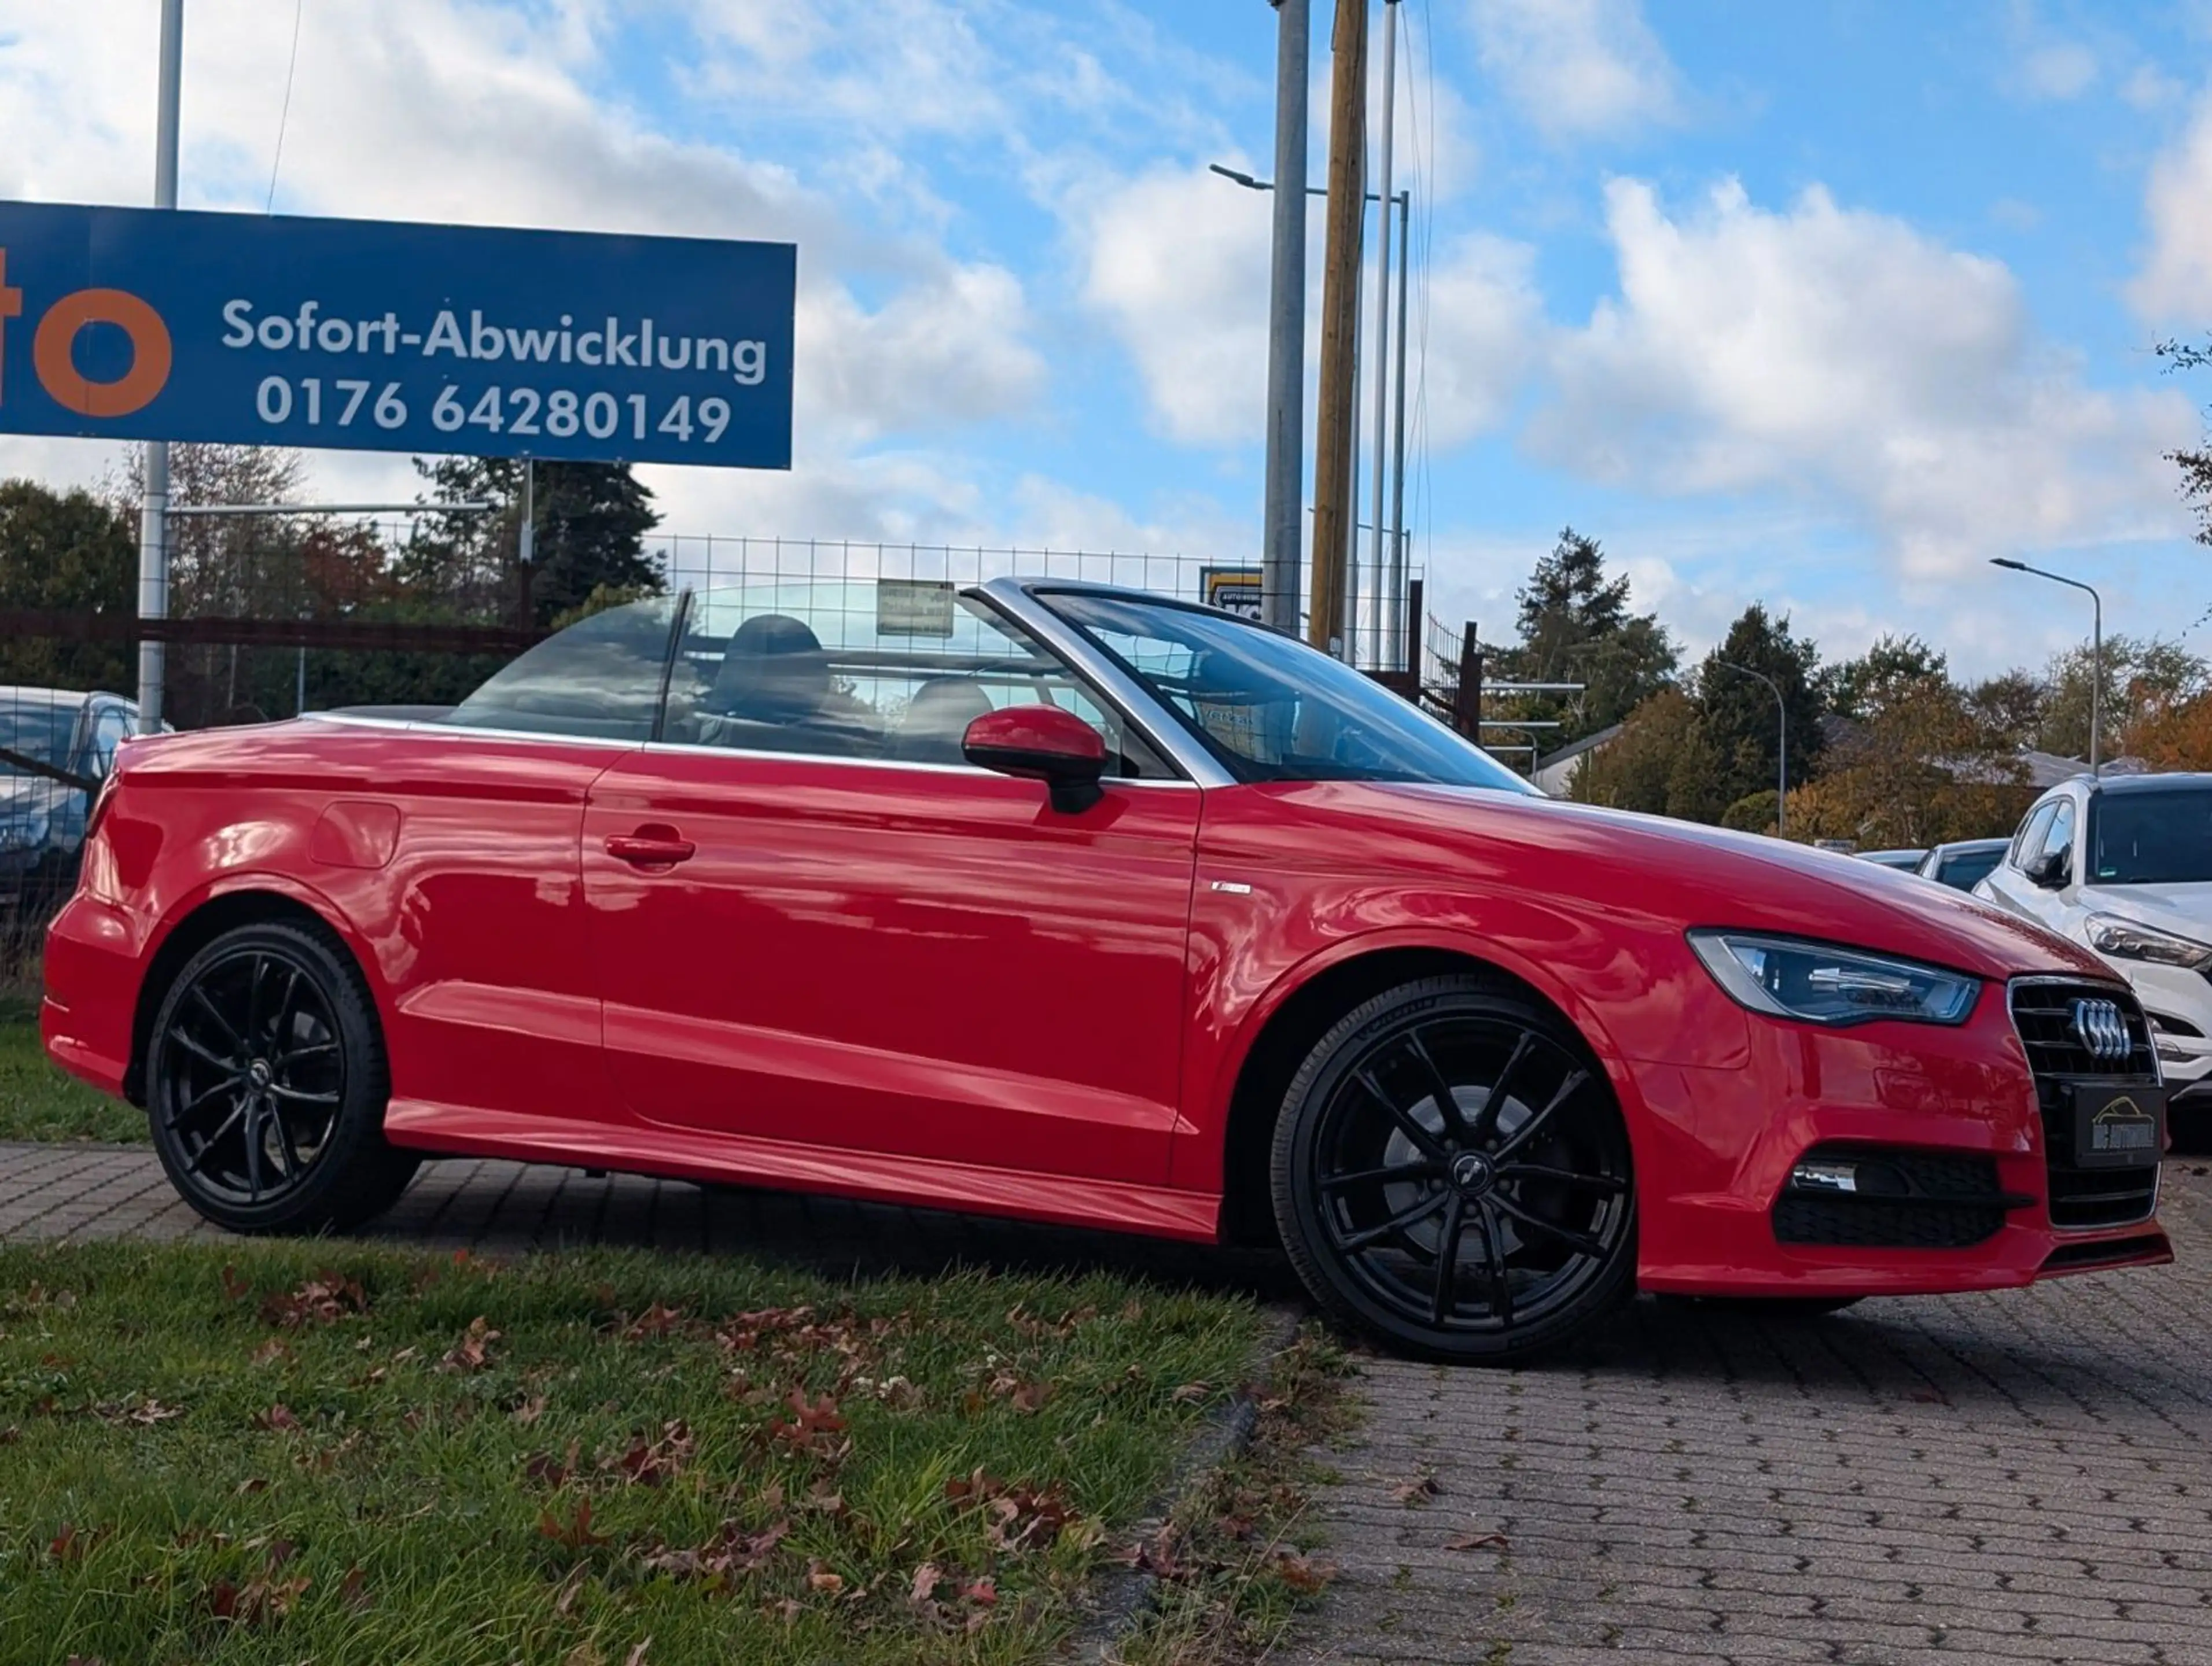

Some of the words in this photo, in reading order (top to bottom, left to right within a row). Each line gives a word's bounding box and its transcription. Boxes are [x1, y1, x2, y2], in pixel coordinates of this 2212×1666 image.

[222, 300, 766, 385] Sofort-Abwicklung
[257, 376, 407, 428] 0176
[432, 385, 731, 444] 64280149
